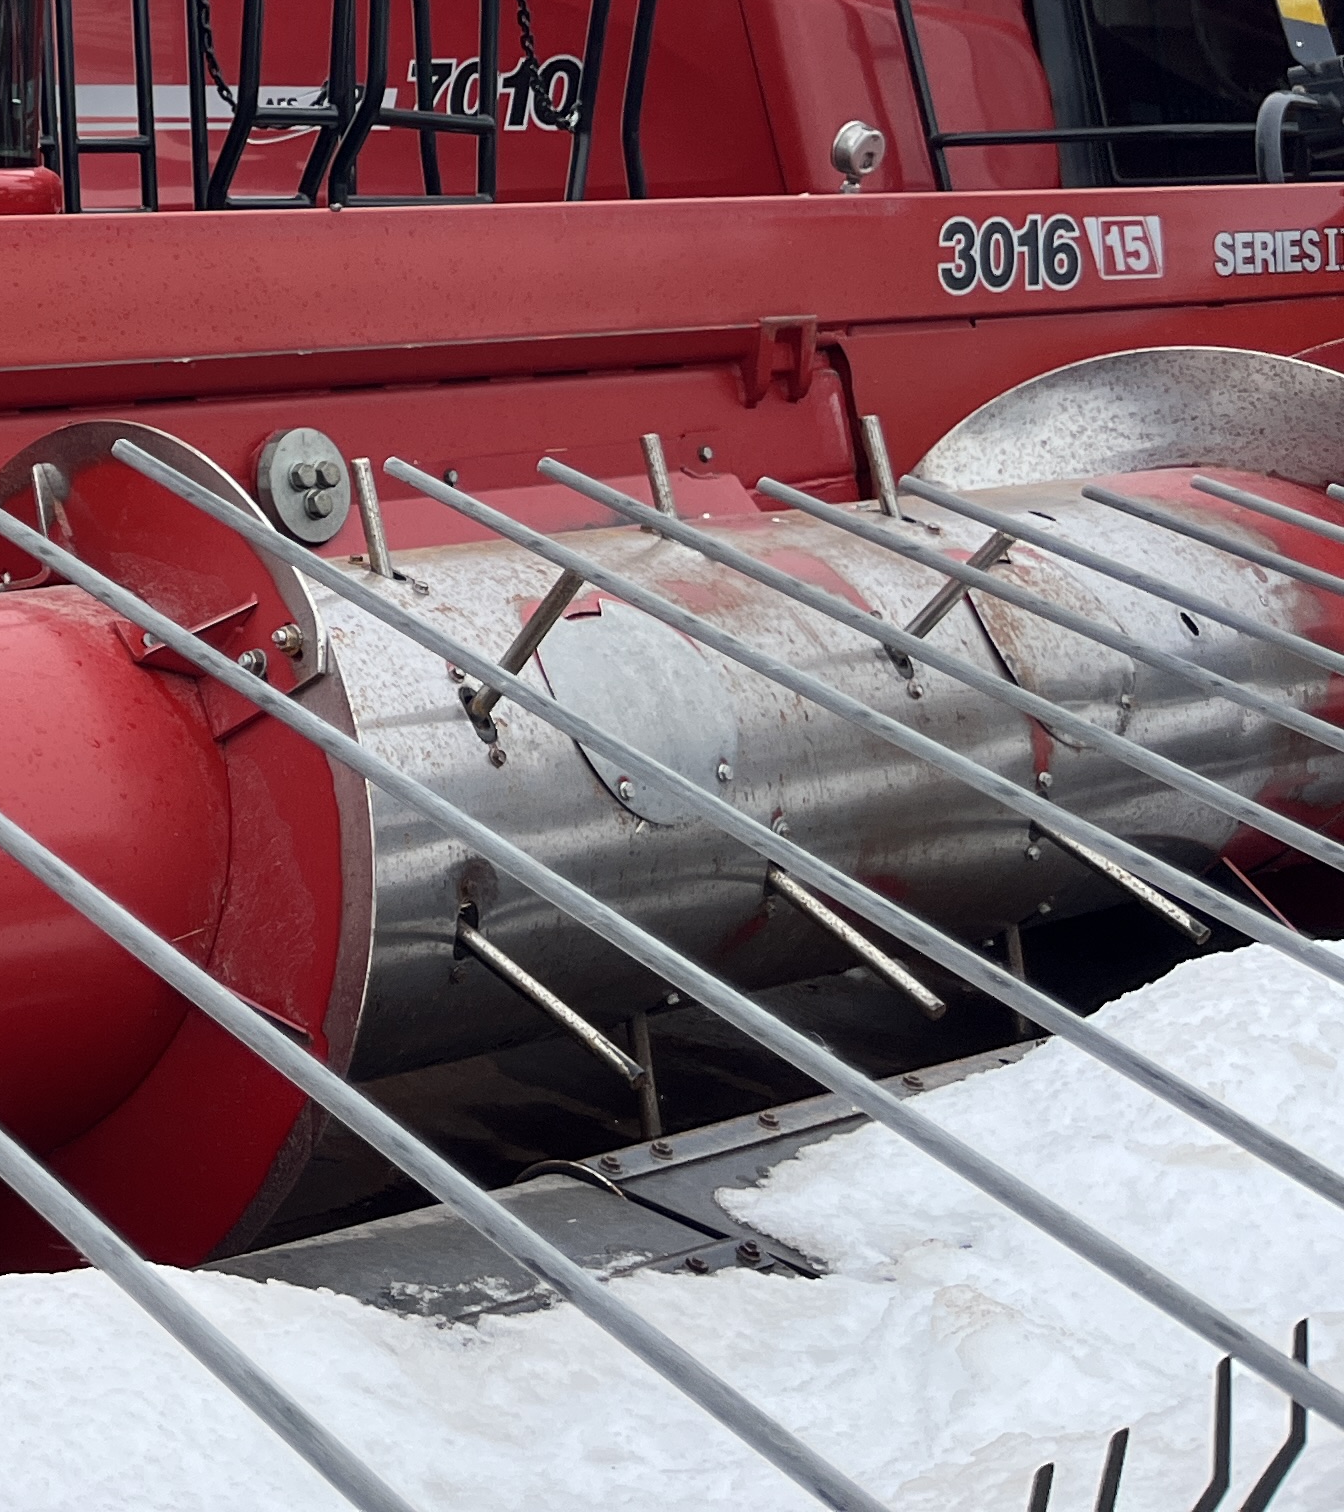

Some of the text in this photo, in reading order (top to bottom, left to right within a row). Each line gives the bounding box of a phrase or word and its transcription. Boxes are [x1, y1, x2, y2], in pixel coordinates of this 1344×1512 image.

[407, 54, 585, 133] 7010
[938, 213, 1152, 297] 3016 15
[1213, 227, 1344, 277] SERIES I
